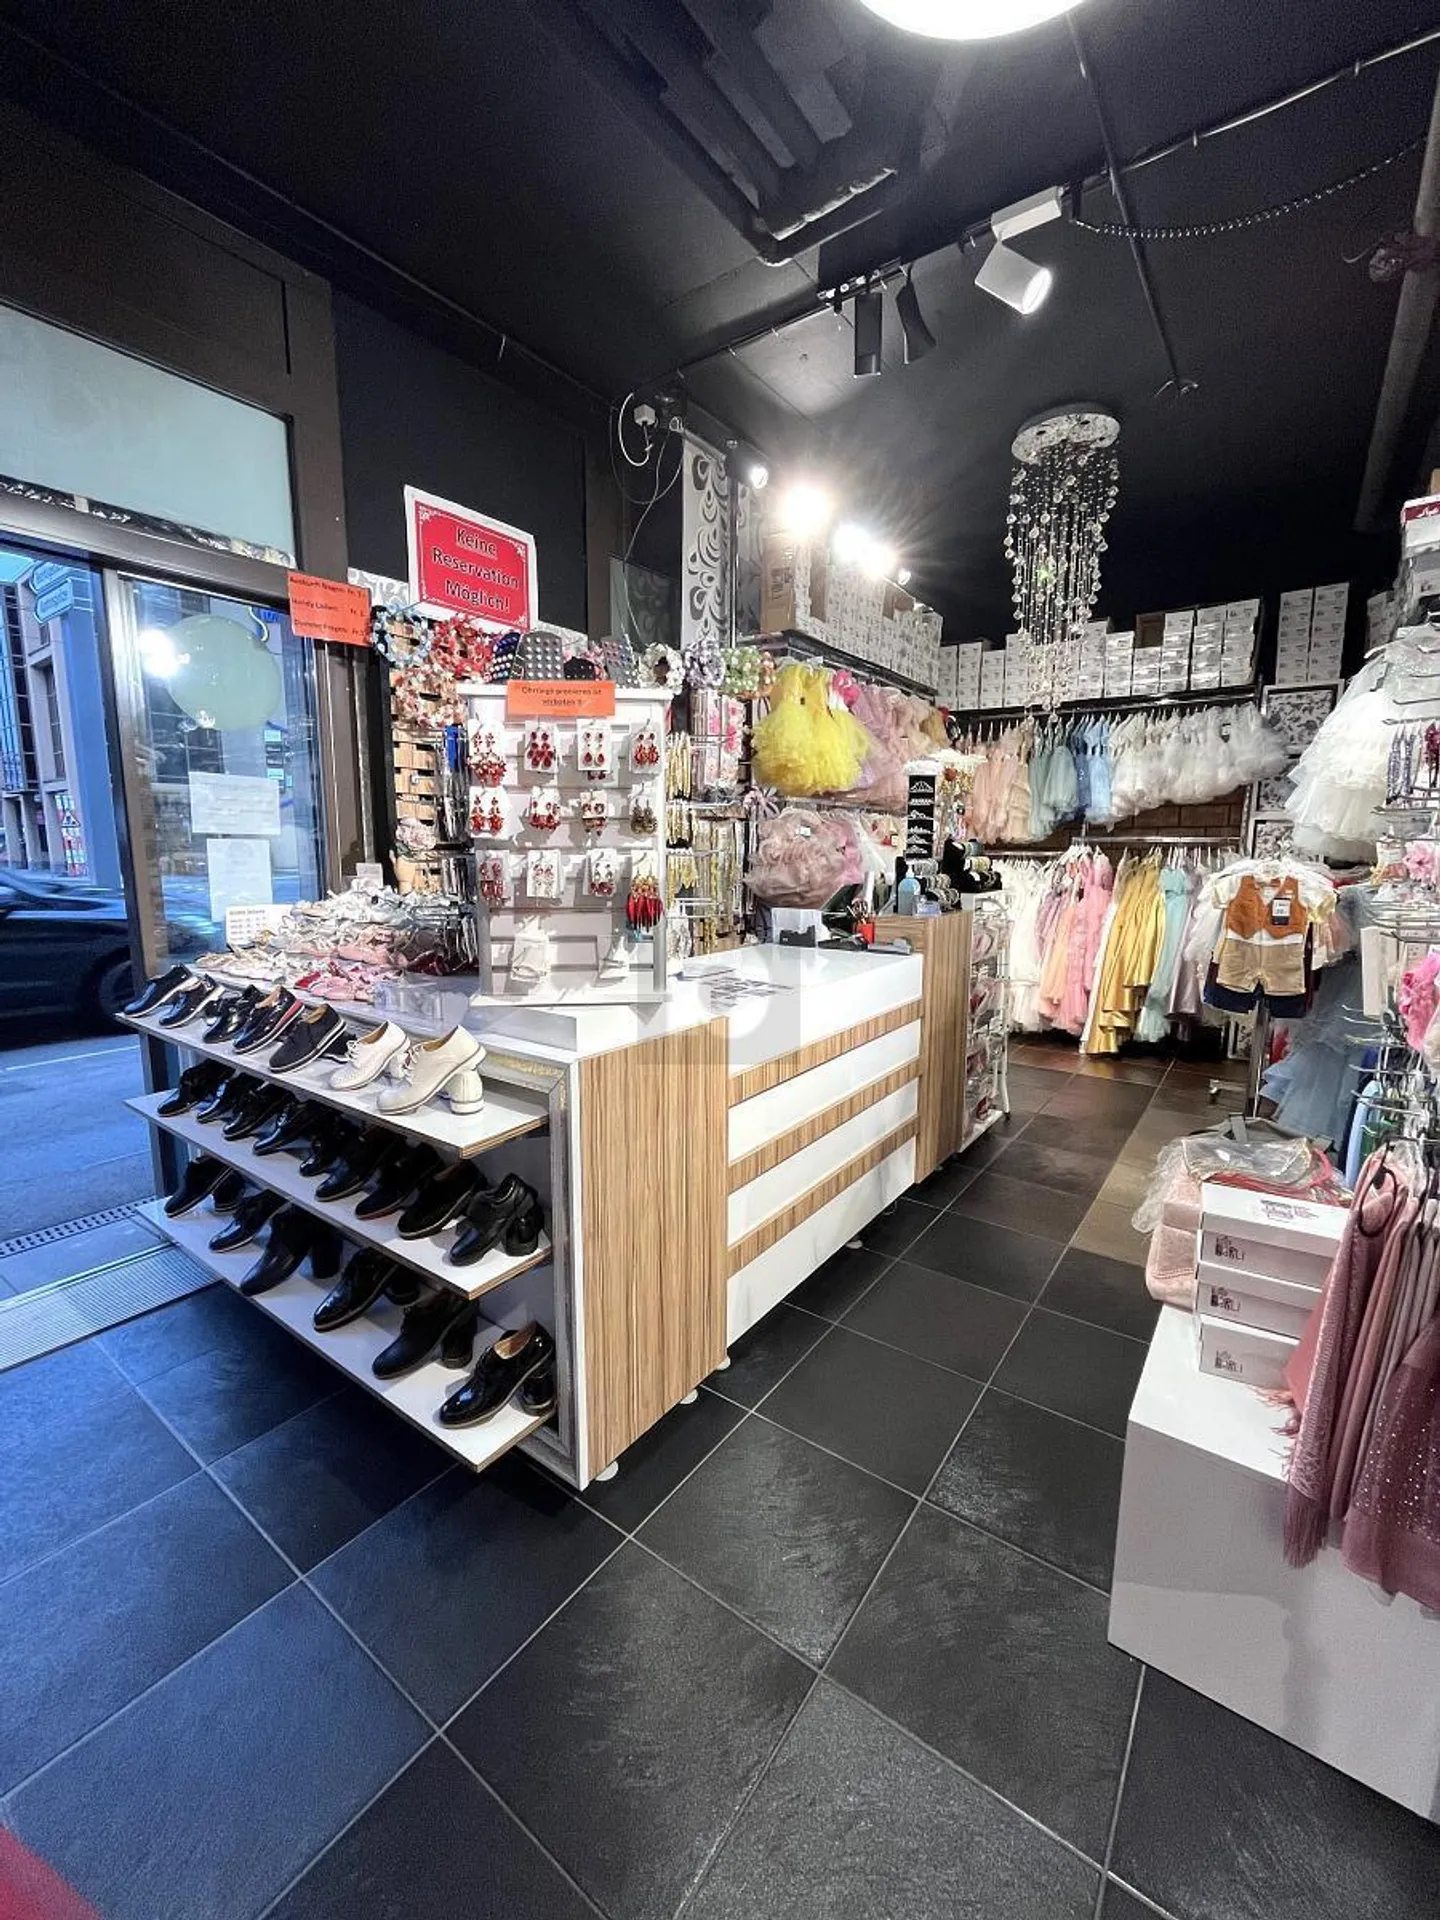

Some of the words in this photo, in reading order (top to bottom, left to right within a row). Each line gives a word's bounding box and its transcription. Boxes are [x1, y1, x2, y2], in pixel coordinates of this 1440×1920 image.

[456, 528, 497, 556] Keine
[432, 547, 518, 588] Reservation
[445, 580, 509, 611] Möglich!
